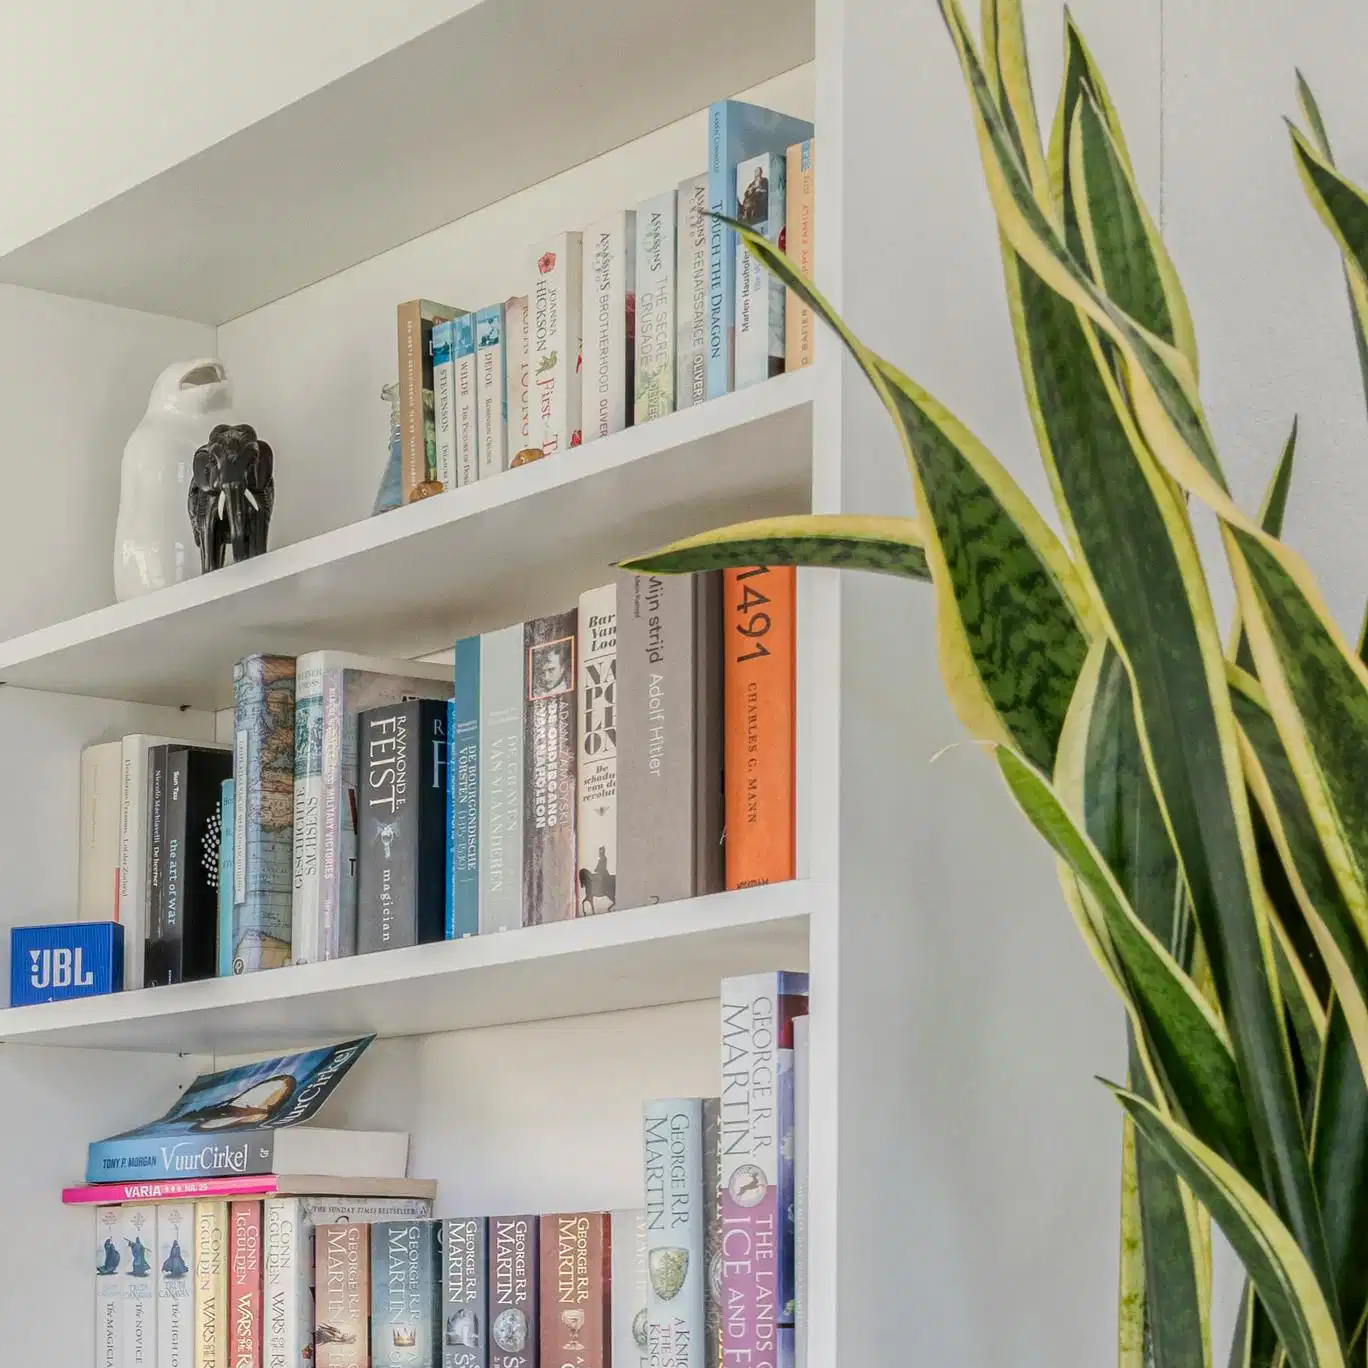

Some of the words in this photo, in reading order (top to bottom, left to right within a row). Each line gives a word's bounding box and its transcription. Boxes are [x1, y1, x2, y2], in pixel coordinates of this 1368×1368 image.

[692, 250, 705, 350] RENAISSANCE
[711, 259, 722, 289] THE
[536, 280, 547, 352] HICKSON
[547, 288, 557, 337] JOANNA
[711, 290, 723, 360] DRAGON
[484, 352, 493, 388] DEFOE
[598, 294, 609, 393] BROTHERHOOD
[440, 368, 448, 433] STEVENSON
[460, 361, 468, 397] WILDE
[599, 398, 609, 438] OLIVER
[648, 618, 664, 666] strijd
[736, 565, 772, 664] 1491
[648, 672, 664, 721] Adolf
[748, 682, 757, 753] CHARLES
[369, 716, 396, 813] FEIST
[395, 715, 407, 795] RAYMOND
[458, 746, 469, 803] VORSTEN
[547, 726, 557, 827] ONDERGANG
[648, 724, 664, 778] Hitler
[535, 741, 546, 829] NAPOLEON
[748, 777, 757, 823] MANN
[153, 800, 161, 844] Machiavelli
[295, 786, 305, 889] GESCHICHTE
[305, 796, 317, 876] SACHSENS
[468, 765, 477, 870] BOURGONDISCHE
[153, 846, 160, 859] De
[169, 860, 177, 880] art
[170, 839, 178, 858] the
[167, 900, 176, 925] war
[381, 868, 391, 942] magician
[30, 947, 94, 988] JBL
[754, 997, 772, 1096] GEORGE
[722, 1001, 751, 1157] MARTIN
[103, 1158, 119, 1169] TONY
[127, 1155, 157, 1168] MORGAN
[159, 1141, 248, 1173] VuurCirkel
[645, 1116, 667, 1231] MARTIN
[670, 1111, 689, 1187] GEORGE
[124, 1184, 162, 1198] VARIA
[212, 1228, 221, 1275] CONN
[233, 1208, 250, 1285] IGGULDEN
[247, 1226, 258, 1271] CONN
[280, 1220, 290, 1269] CONN
[348, 1227, 360, 1292] GEORGE
[407, 1226, 420, 1291] GEORGE
[449, 1222, 465, 1303] MARTIN
[465, 1221, 478, 1276] GEORGE
[496, 1221, 515, 1304] MARTIN
[514, 1221, 527, 1277] GEORGE
[559, 1218, 575, 1304] MARTIN
[577, 1217, 589, 1272] GEORGE
[724, 1215, 751, 1279] ICE
[754, 1214, 772, 1261] THE
[327, 1229, 347, 1324] MARTIN
[388, 1228, 407, 1324] MARTIN
[203, 1296, 216, 1342] WARS
[236, 1292, 254, 1337] WARS
[272, 1291, 285, 1338] WARS
[727, 1286, 746, 1336] AND
[754, 1271, 772, 1352] LANDS
[135, 1319, 144, 1365] NOVICE
